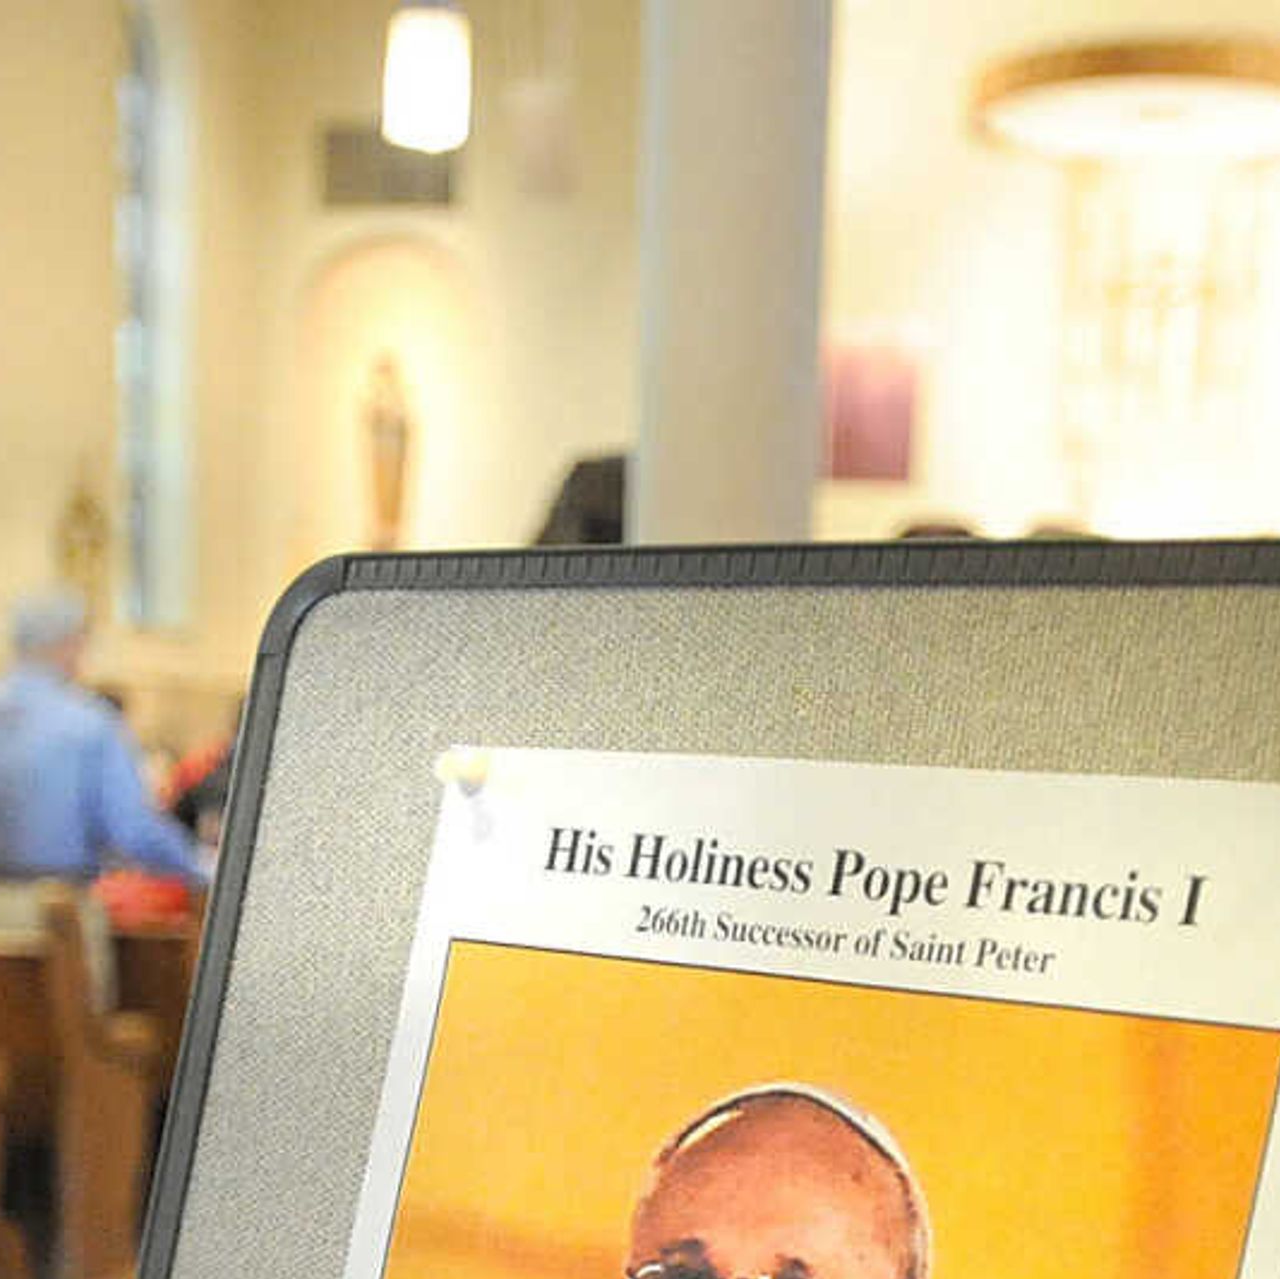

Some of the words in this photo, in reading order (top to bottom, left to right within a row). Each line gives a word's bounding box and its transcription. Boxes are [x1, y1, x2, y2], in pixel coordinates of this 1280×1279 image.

[543, 827, 613, 876] His
[625, 833, 812, 894] Holiness
[828, 849, 949, 916] Pope
[966, 860, 1162, 924] Francis
[1181, 875, 1209, 926] I
[634, 904, 707, 943] 266th
[712, 911, 847, 954] Successor
[854, 930, 886, 957] of
[889, 933, 966, 968] Saint
[975, 940, 1056, 976] Peter
